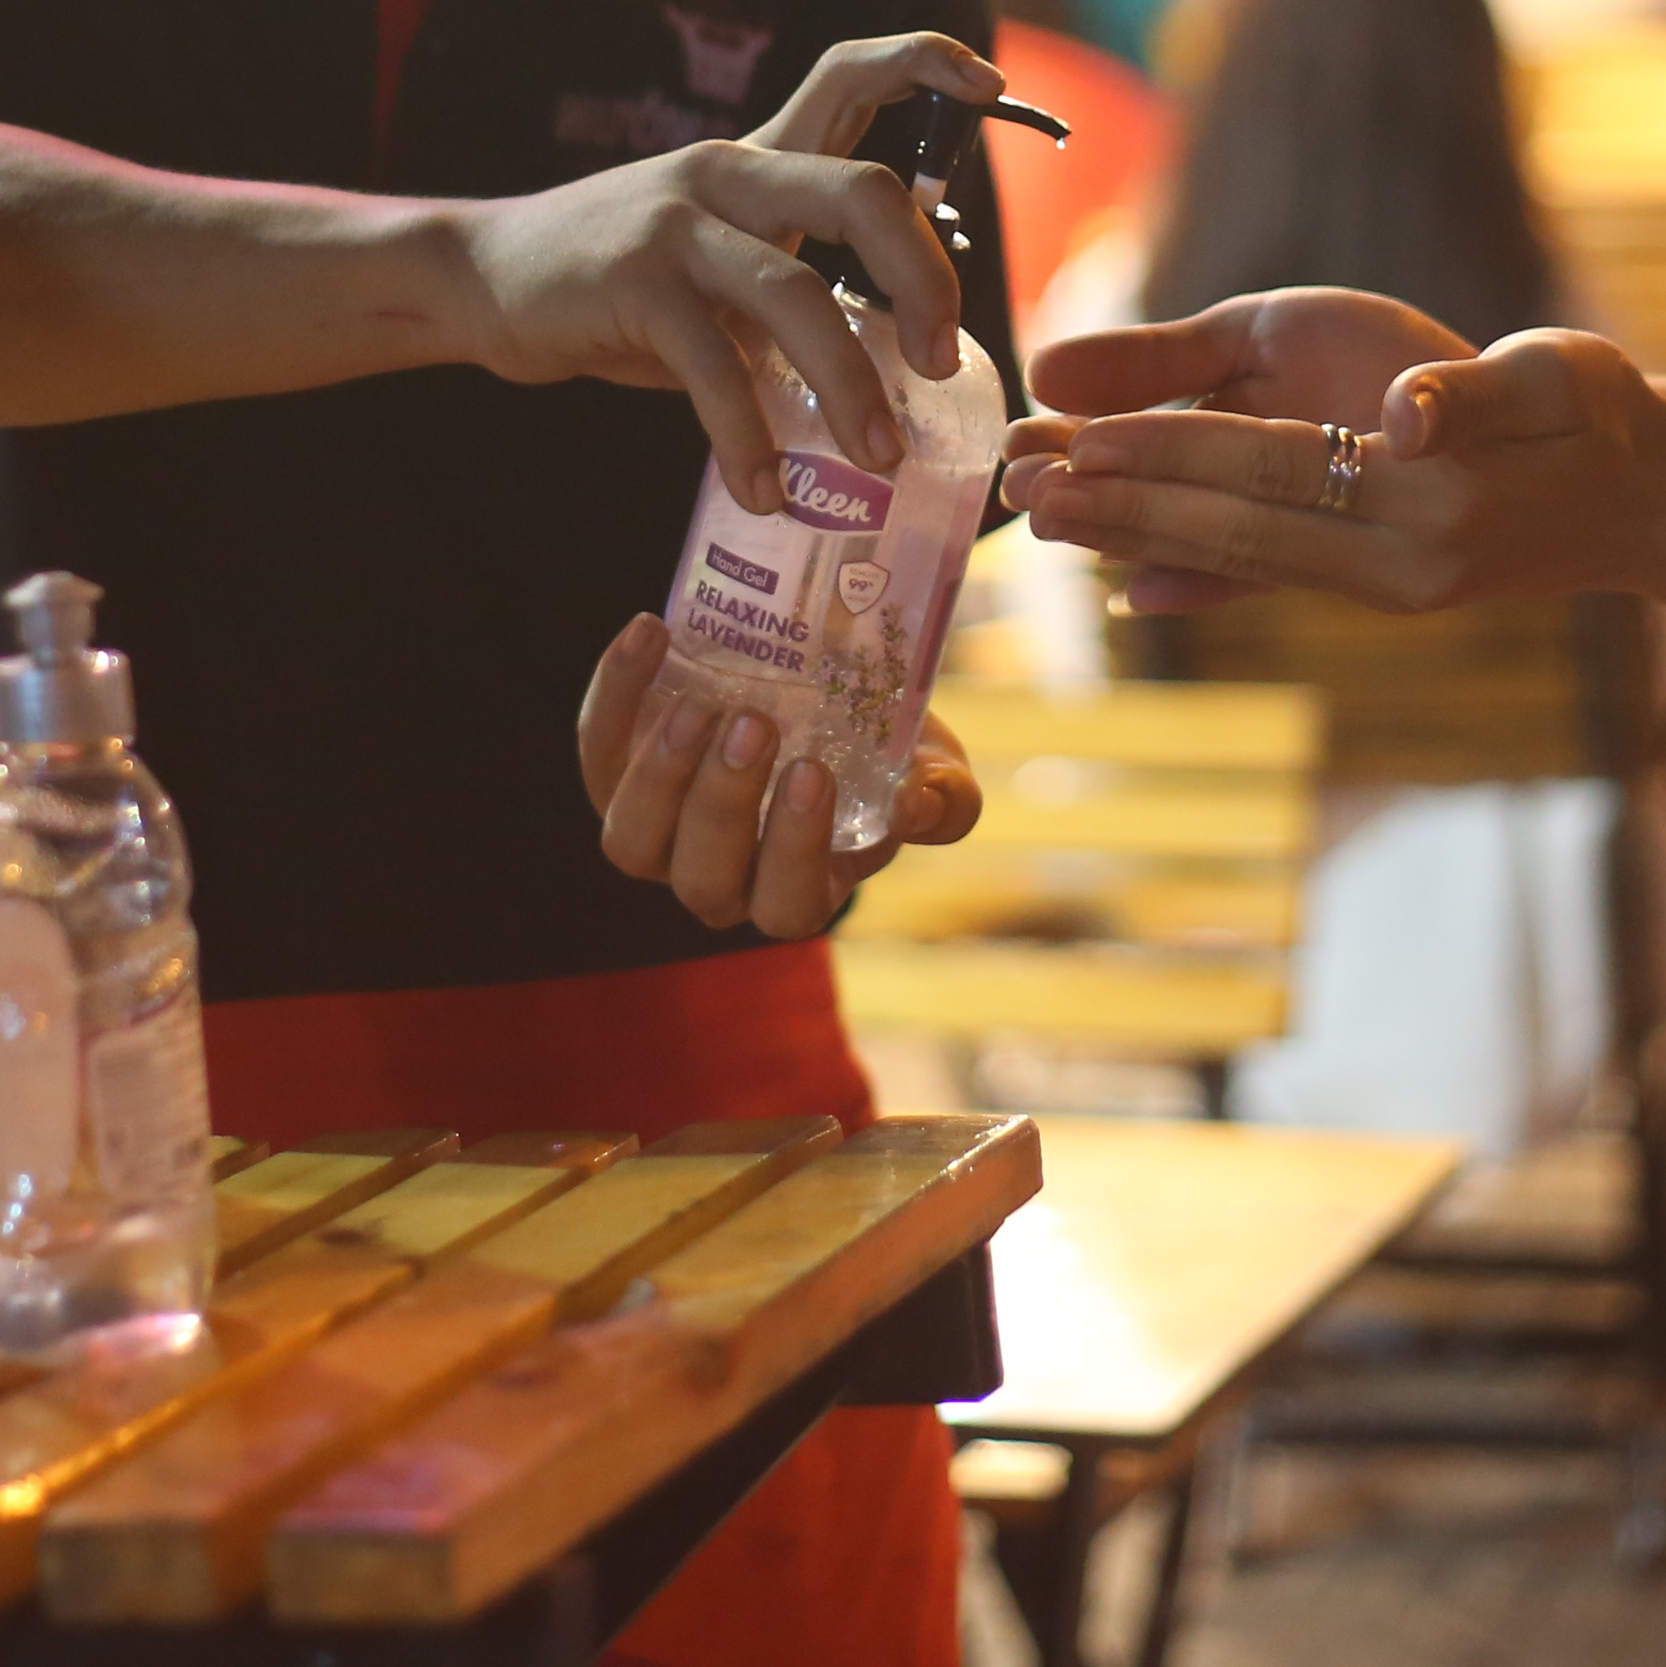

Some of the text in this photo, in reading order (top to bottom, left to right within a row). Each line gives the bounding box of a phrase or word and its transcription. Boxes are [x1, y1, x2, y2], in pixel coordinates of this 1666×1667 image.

[711, 549, 769, 588] Hand Gel
[687, 607, 806, 673] LAVENDER
[695, 579, 810, 643] RELAXING
